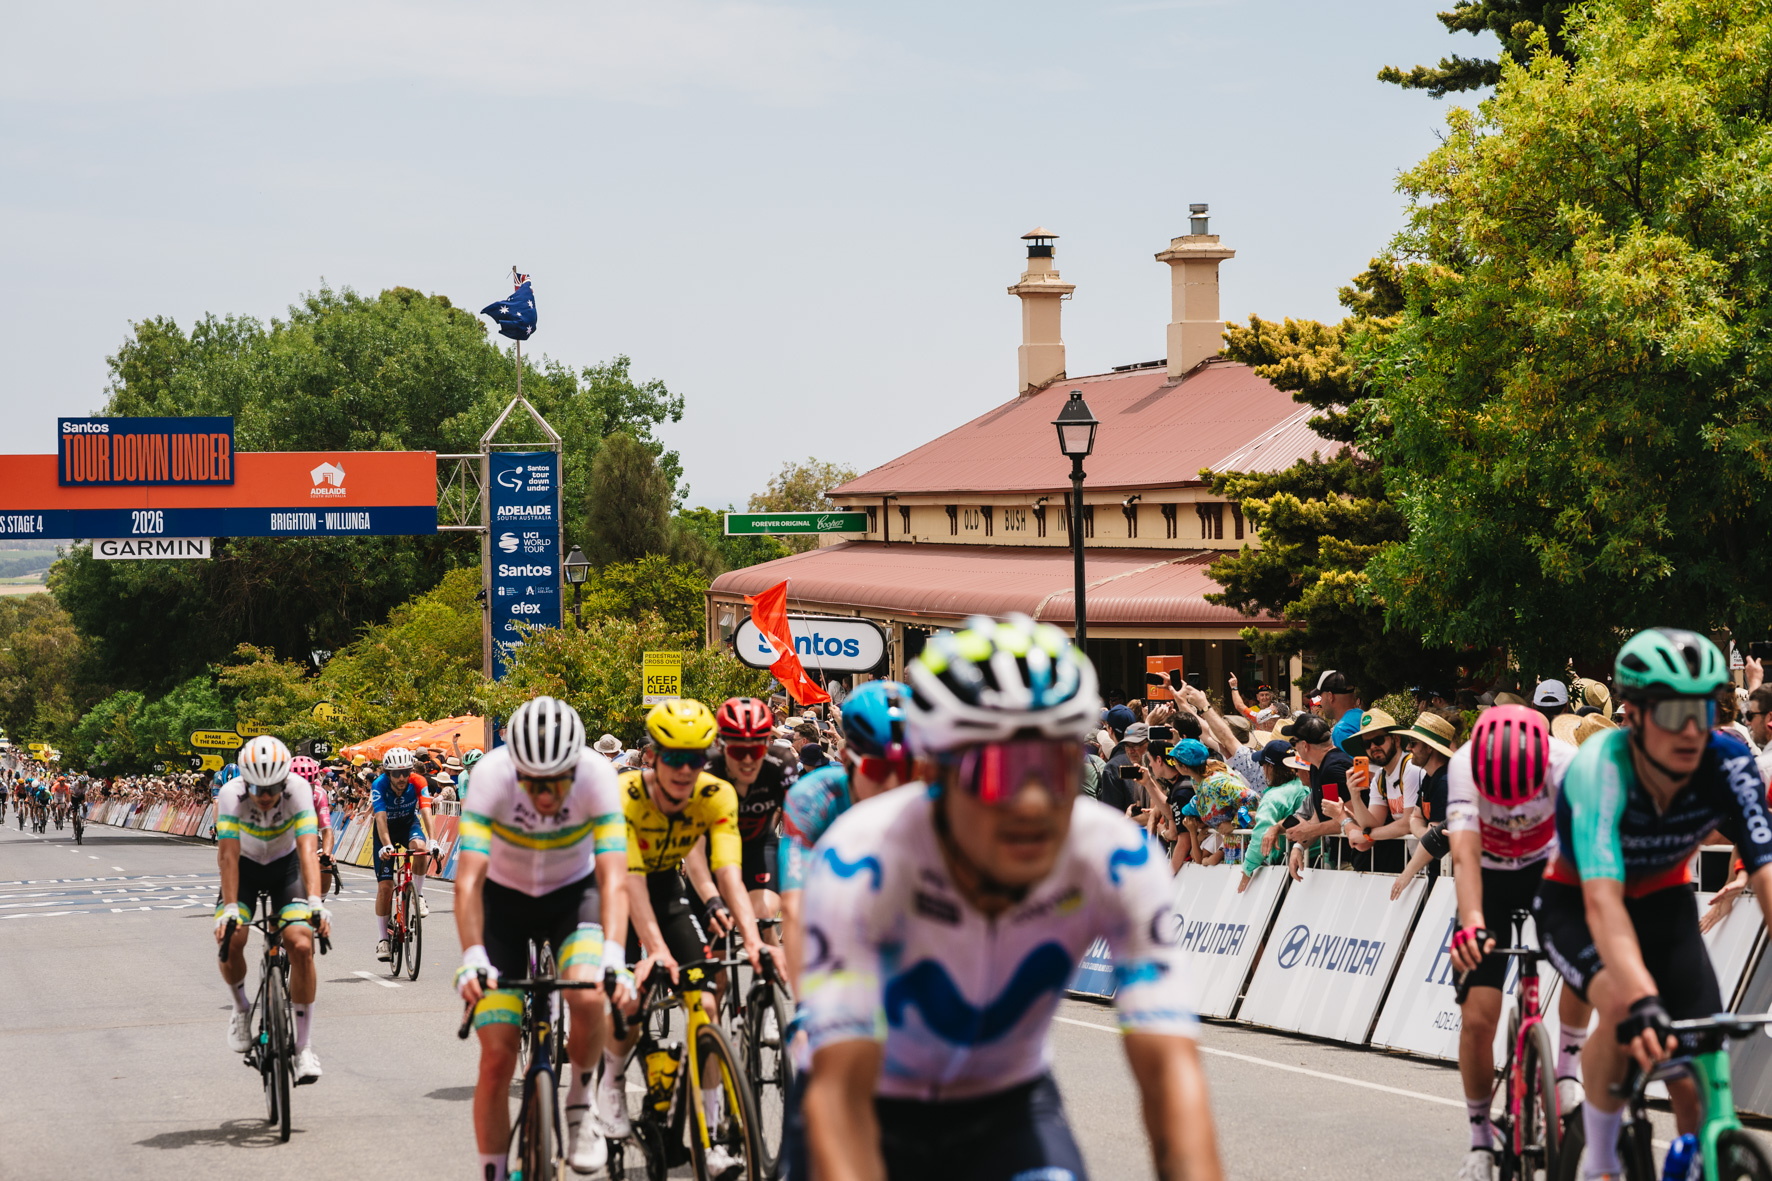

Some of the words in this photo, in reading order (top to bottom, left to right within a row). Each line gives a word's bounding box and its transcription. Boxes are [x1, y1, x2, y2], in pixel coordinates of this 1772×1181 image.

[62, 422, 109, 433] Santos
[63, 434, 110, 482] TOUR
[113, 434, 169, 481] DOWN
[172, 433, 230, 480] UNDER
[497, 505, 551, 515] ADELAIDE
[7, 515, 35, 533] STAGE
[36, 515, 43, 533] 4
[132, 511, 163, 534] 2026
[270, 513, 316, 531] BRIGHTON
[325, 512, 371, 530] WILLUNGA
[964, 508, 980, 530] OLD
[1004, 509, 1026, 531] BUSH
[1057, 508, 1067, 531] IN
[101, 540, 203, 556] GARMIN
[524, 538, 551, 546] WORLD
[524, 545, 545, 553] TOUR
[498, 564, 552, 577] Santos
[511, 602, 541, 614] efex
[759, 632, 860, 658] Sntos
[647, 676, 677, 684] KEEP
[647, 685, 677, 694] CLEAR
[314, 743, 328, 754] 25
[191, 758, 201, 766] 75
[1719, 755, 1772, 845] Adecco
[1182, 920, 1250, 956] HYUNDAI
[1305, 933, 1386, 976] HYUNDAI
[1432, 1010, 1462, 1032] ADELA
